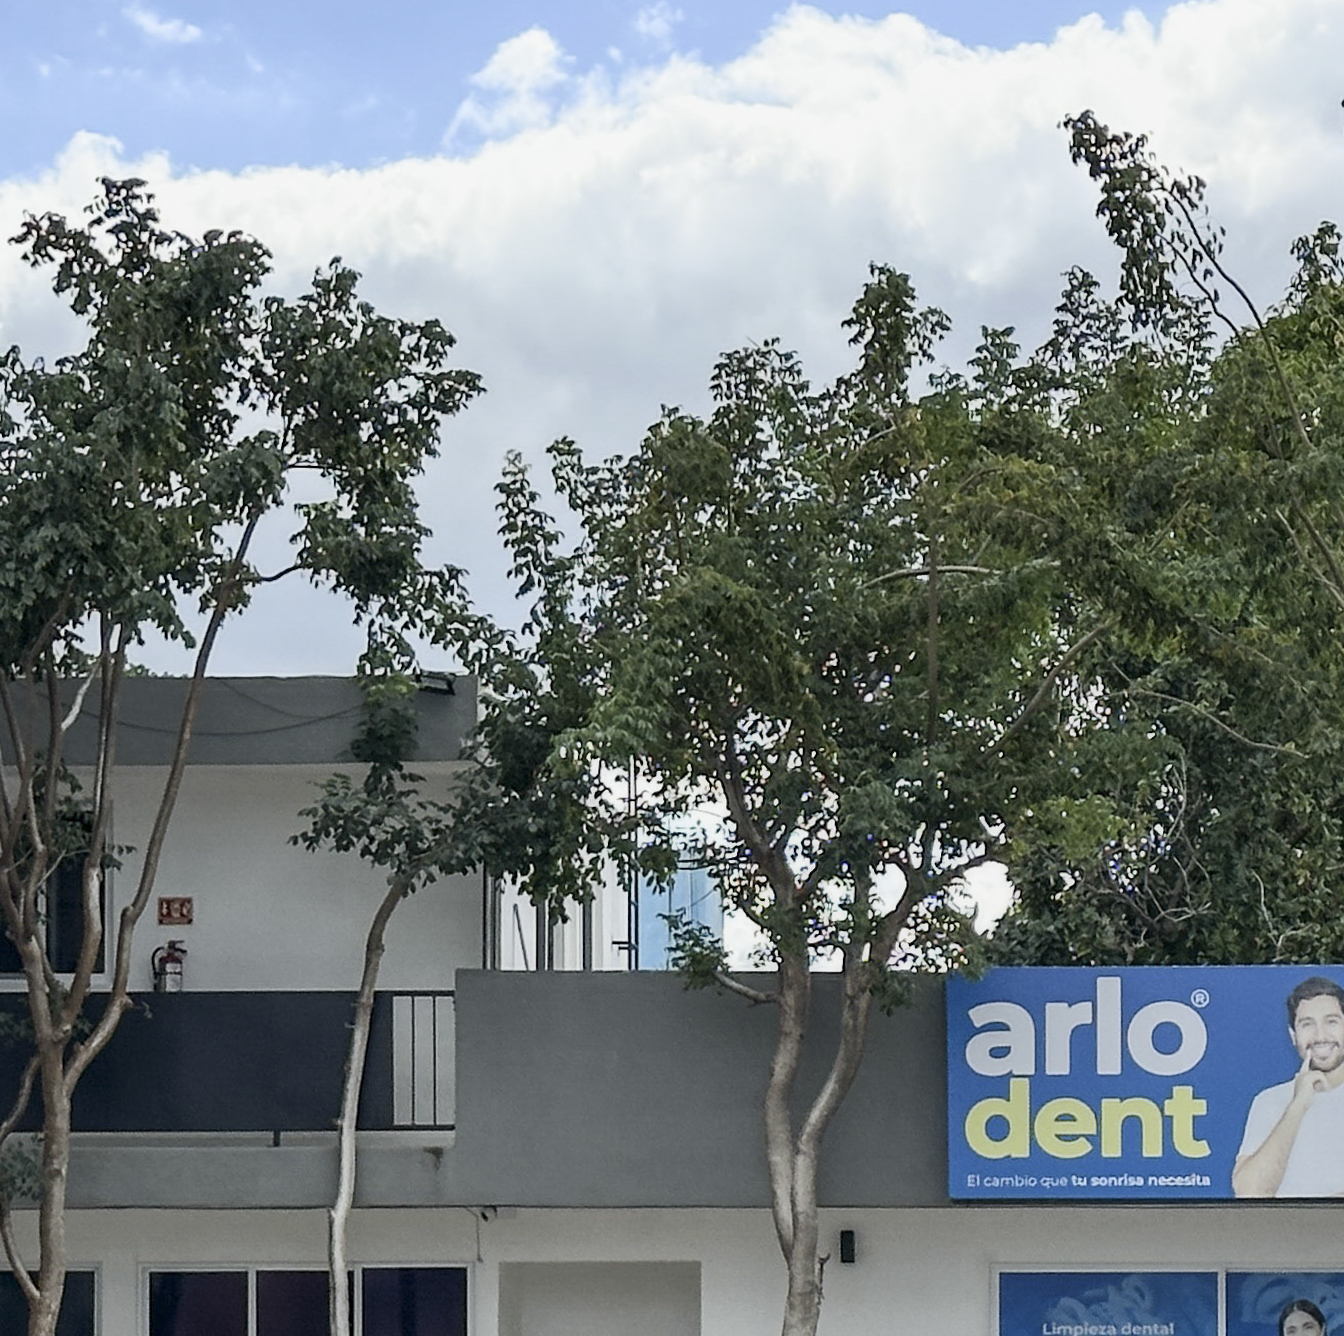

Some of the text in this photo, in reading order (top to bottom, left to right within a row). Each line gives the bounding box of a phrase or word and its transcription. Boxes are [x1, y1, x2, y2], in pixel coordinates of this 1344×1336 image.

[964, 1077, 1212, 1160] dent
[967, 1174, 1212, 1190] El cambio que tu sonrisa necesita
[1121, 1322, 1175, 1336] dental
